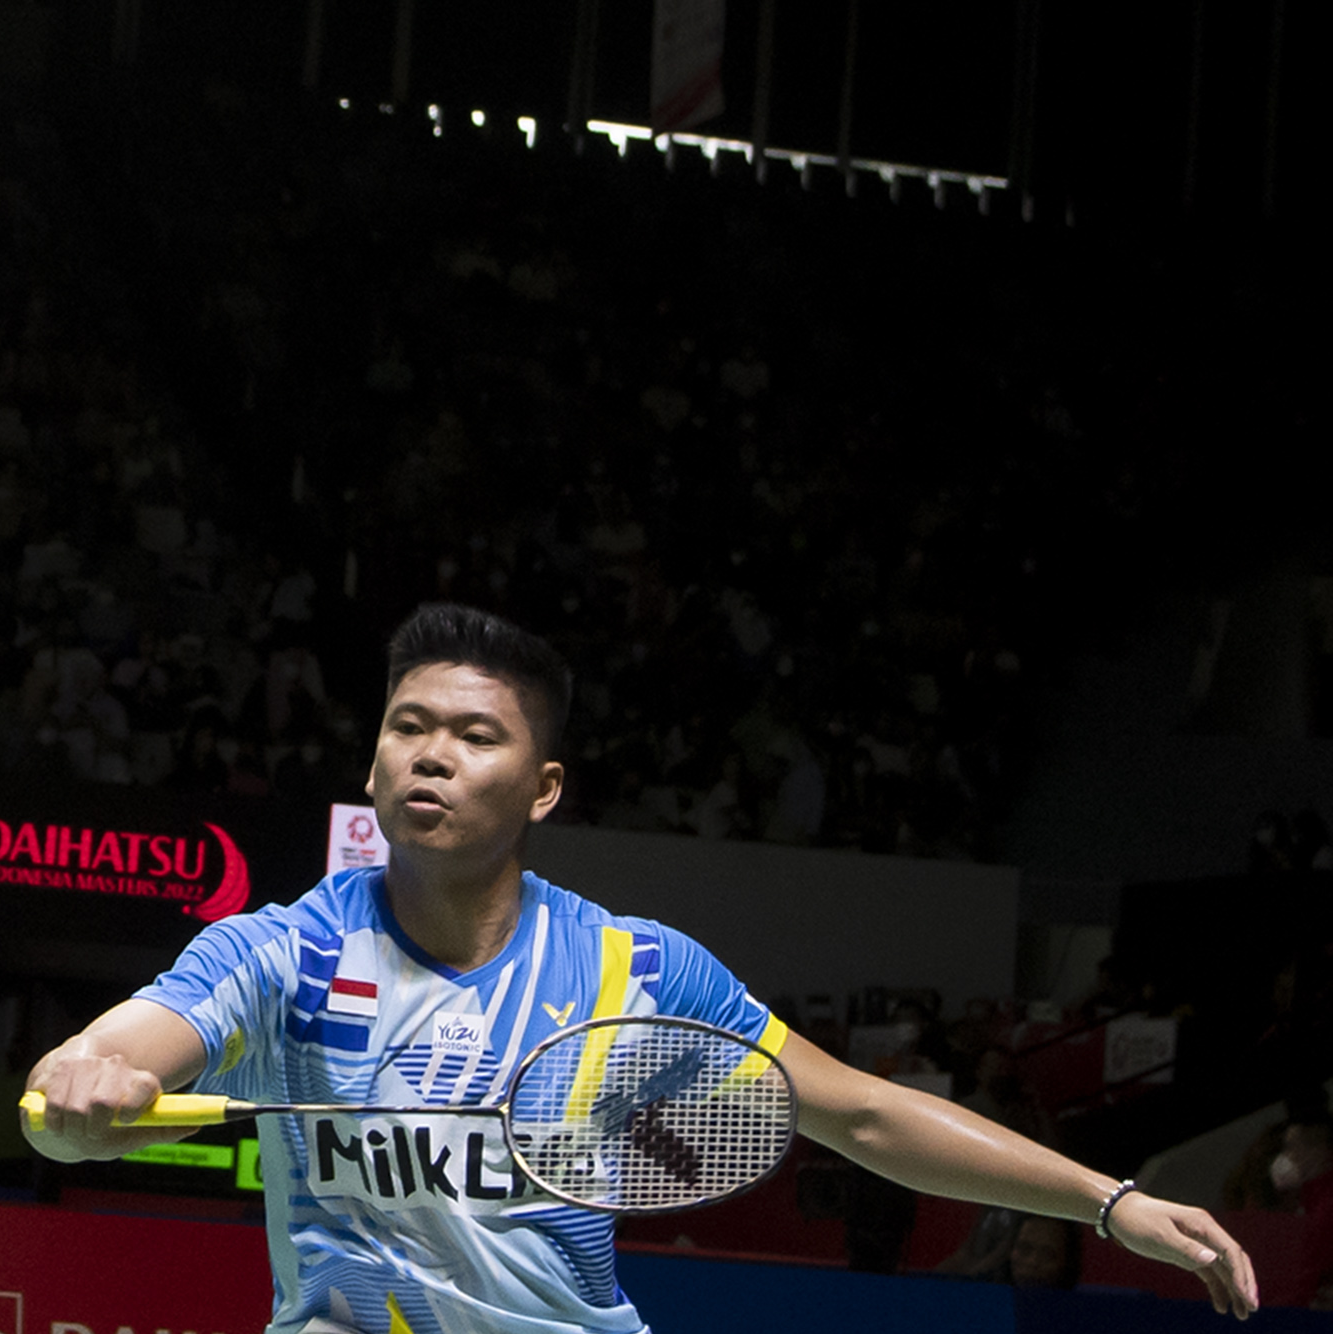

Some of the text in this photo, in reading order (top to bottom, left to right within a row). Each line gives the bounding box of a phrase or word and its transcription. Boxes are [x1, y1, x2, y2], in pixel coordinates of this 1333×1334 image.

[76, 871, 159, 898] MASTERS
[161, 881, 205, 902] 2022
[437, 1022, 481, 1043] YUZU
[433, 1040, 481, 1053] ISOTONIC
